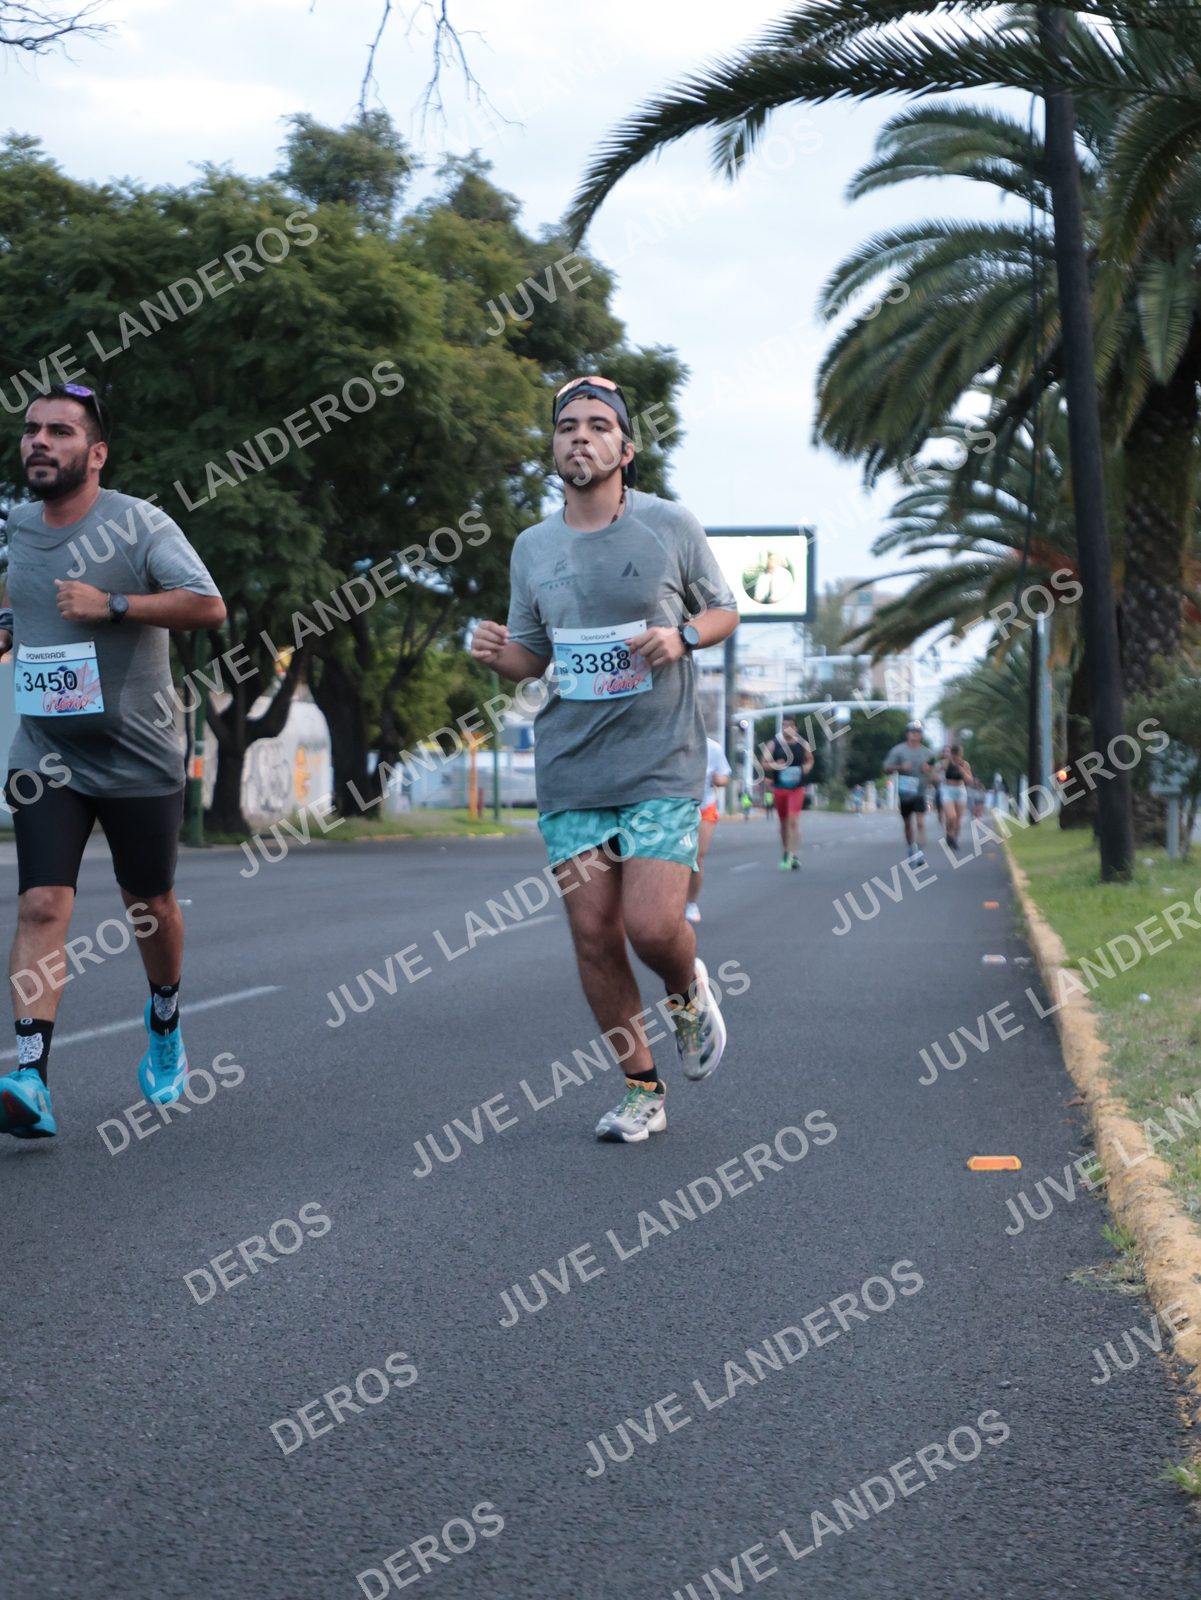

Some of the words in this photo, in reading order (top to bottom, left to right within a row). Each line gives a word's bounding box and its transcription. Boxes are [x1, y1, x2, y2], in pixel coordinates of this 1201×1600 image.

[26, 651, 67, 660] POWERADE
[571, 650, 631, 674] 3388
[23, 671, 78, 692] 3450
